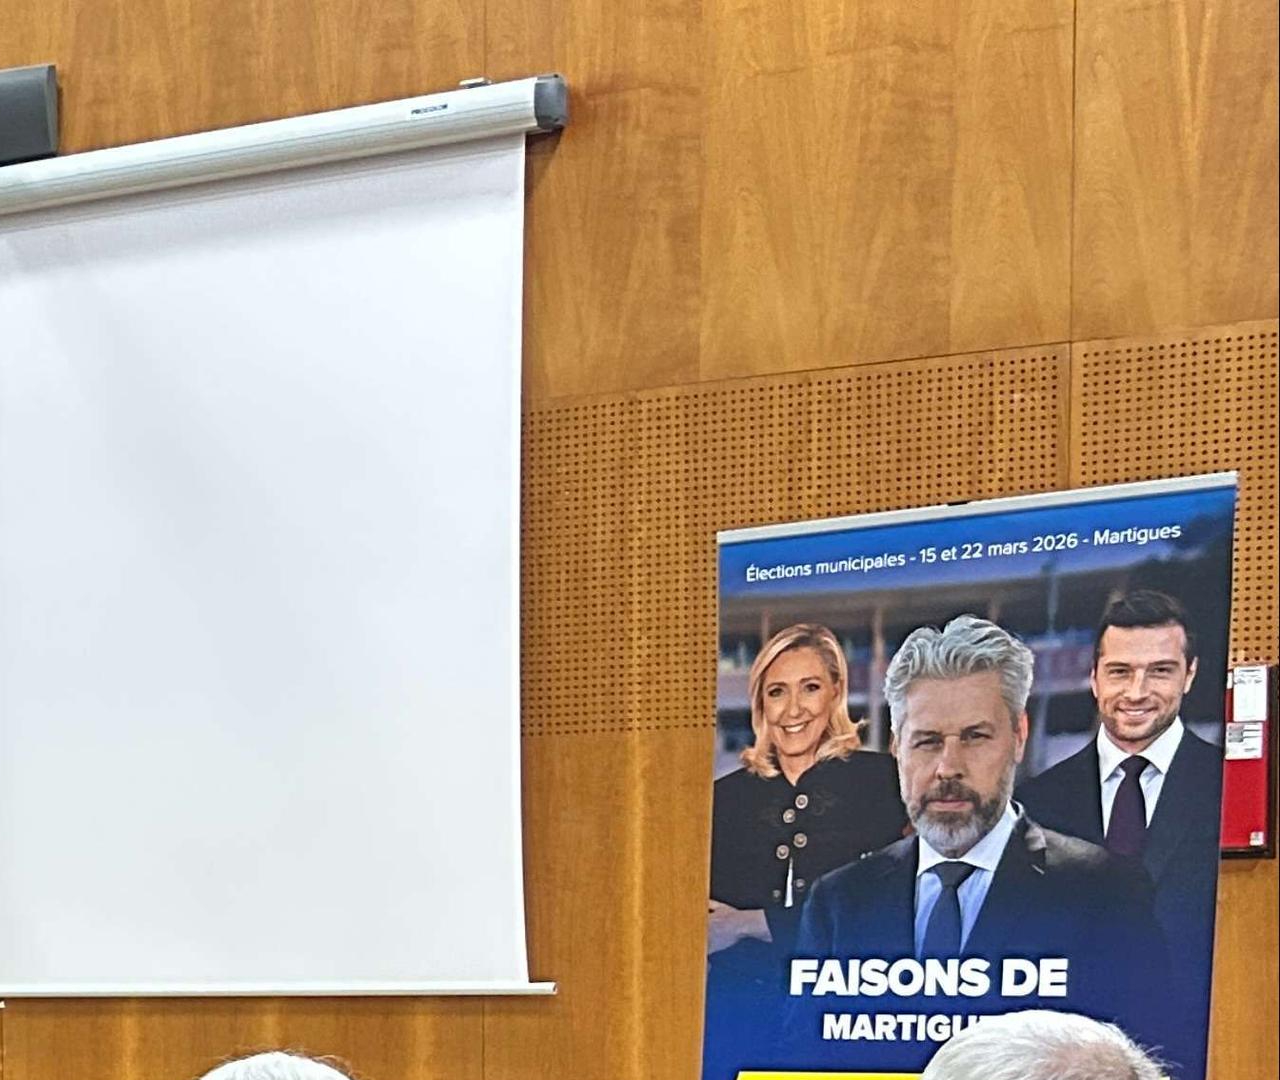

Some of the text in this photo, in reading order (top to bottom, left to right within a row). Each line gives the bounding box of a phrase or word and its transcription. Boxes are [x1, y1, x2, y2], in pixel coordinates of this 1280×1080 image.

[746, 563, 812, 582] Élections
[816, 553, 906, 574] municipales
[919, 547, 937, 563] 15
[941, 546, 957, 561] et
[961, 542, 983, 560] 22
[988, 541, 1028, 557] mars
[1032, 533, 1078, 552] 2026
[1093, 525, 1181, 546] Martigues
[790, 958, 1068, 997] FAISONS DE
[823, 1013, 977, 1042] MARTIGU
